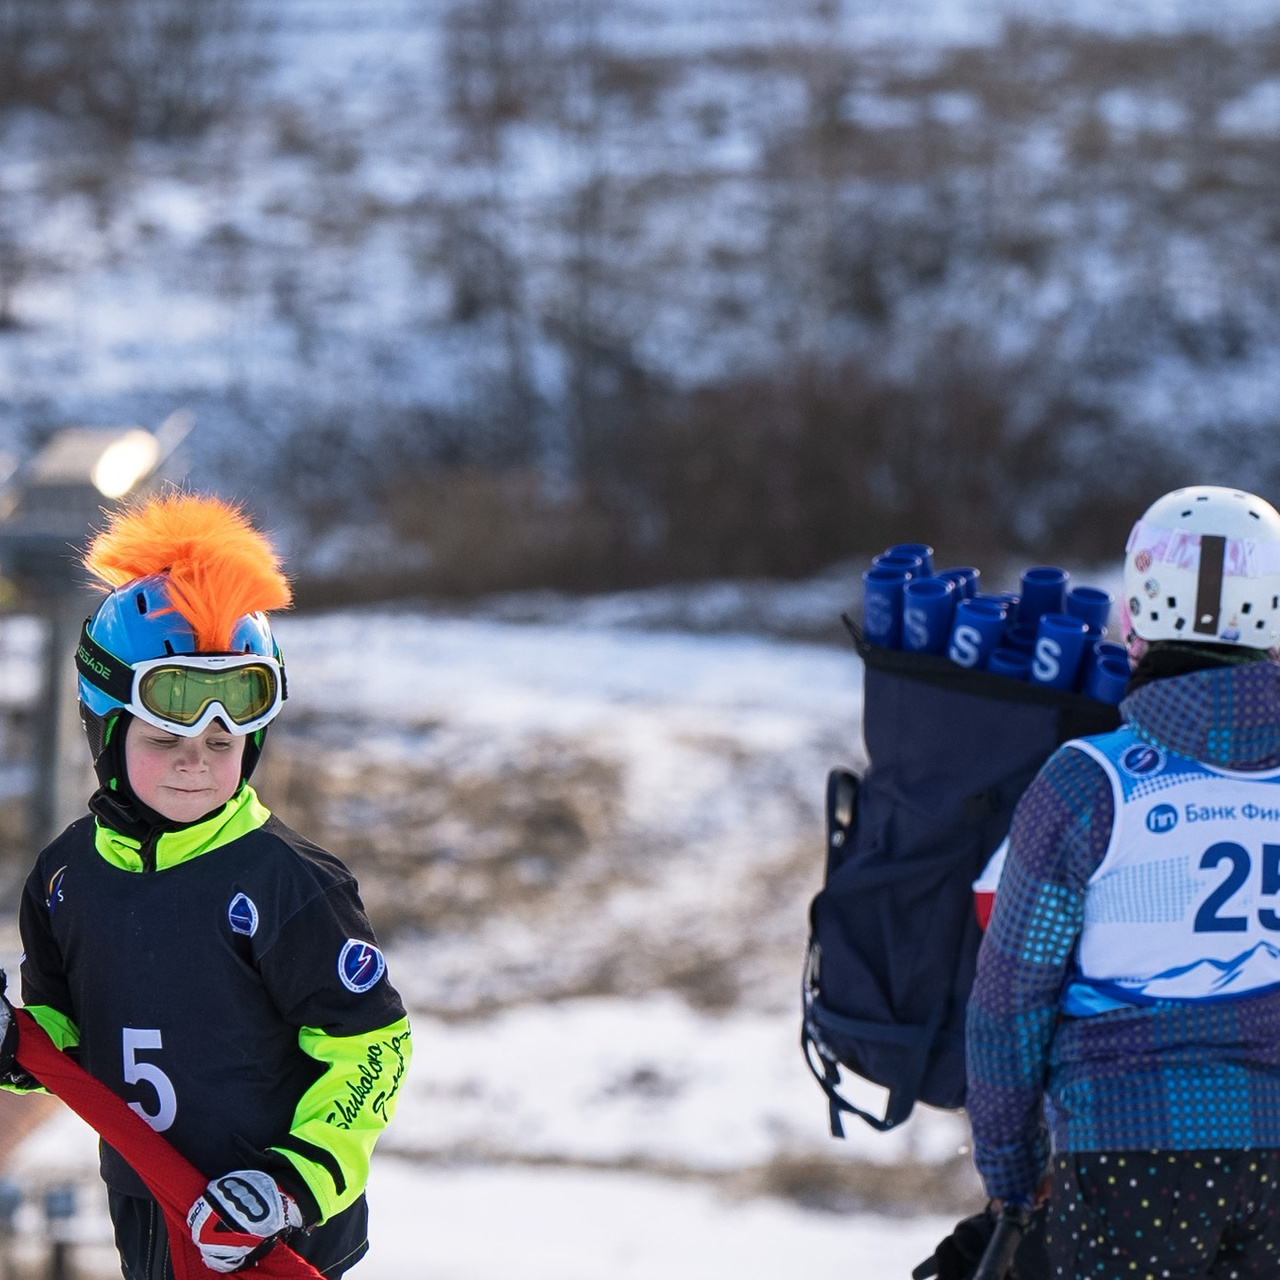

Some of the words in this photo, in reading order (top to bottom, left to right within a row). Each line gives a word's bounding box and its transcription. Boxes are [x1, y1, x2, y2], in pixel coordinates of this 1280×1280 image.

[949, 624, 983, 668] S
[1032, 637, 1062, 681] S
[1185, 803, 1237, 823] Банк
[122, 1027, 177, 1133] 5
